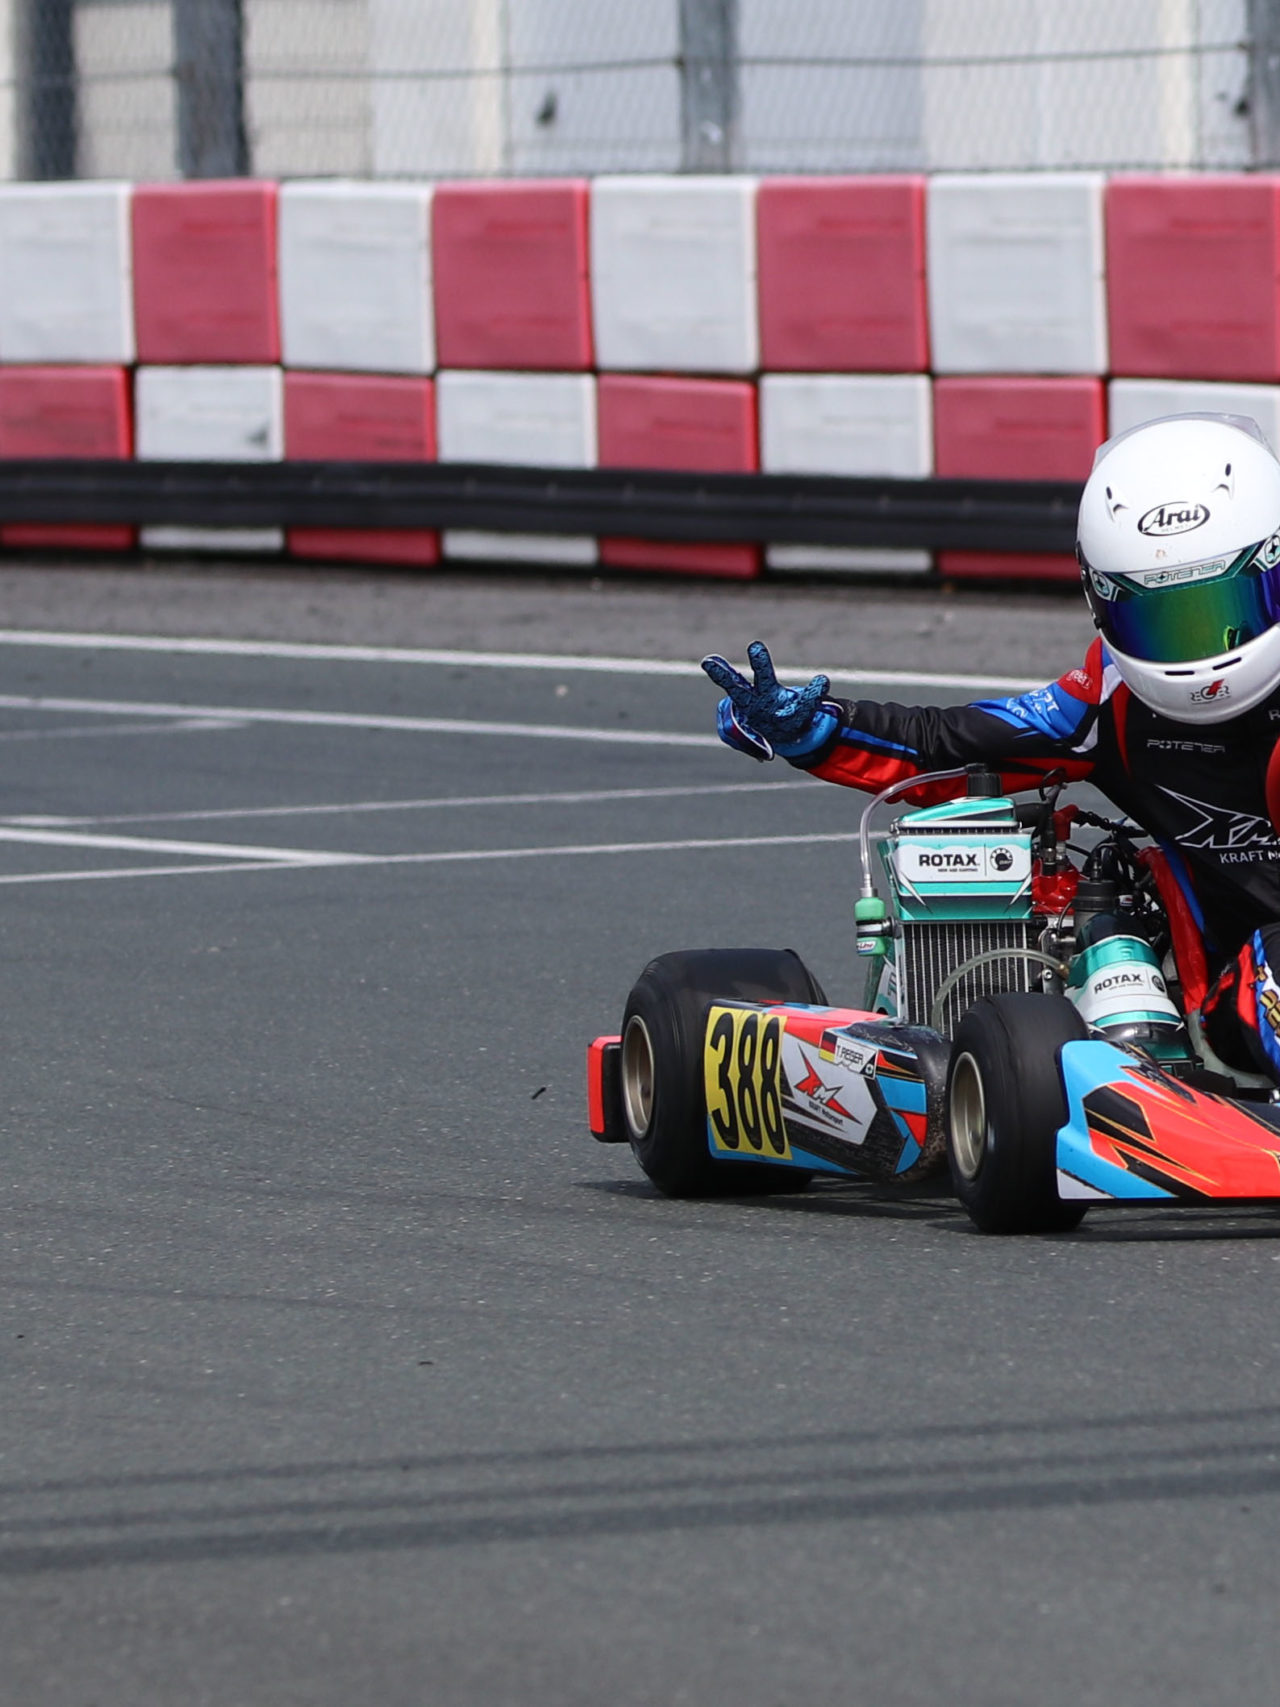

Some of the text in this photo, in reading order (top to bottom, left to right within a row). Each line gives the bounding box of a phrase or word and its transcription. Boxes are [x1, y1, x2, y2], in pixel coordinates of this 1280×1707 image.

[1143, 504, 1200, 531] Arai
[919, 854, 976, 866] ROTAX
[1219, 850, 1264, 864] KRAFT
[1094, 973, 1142, 994] ROTAX
[710, 1012, 785, 1155] 388
